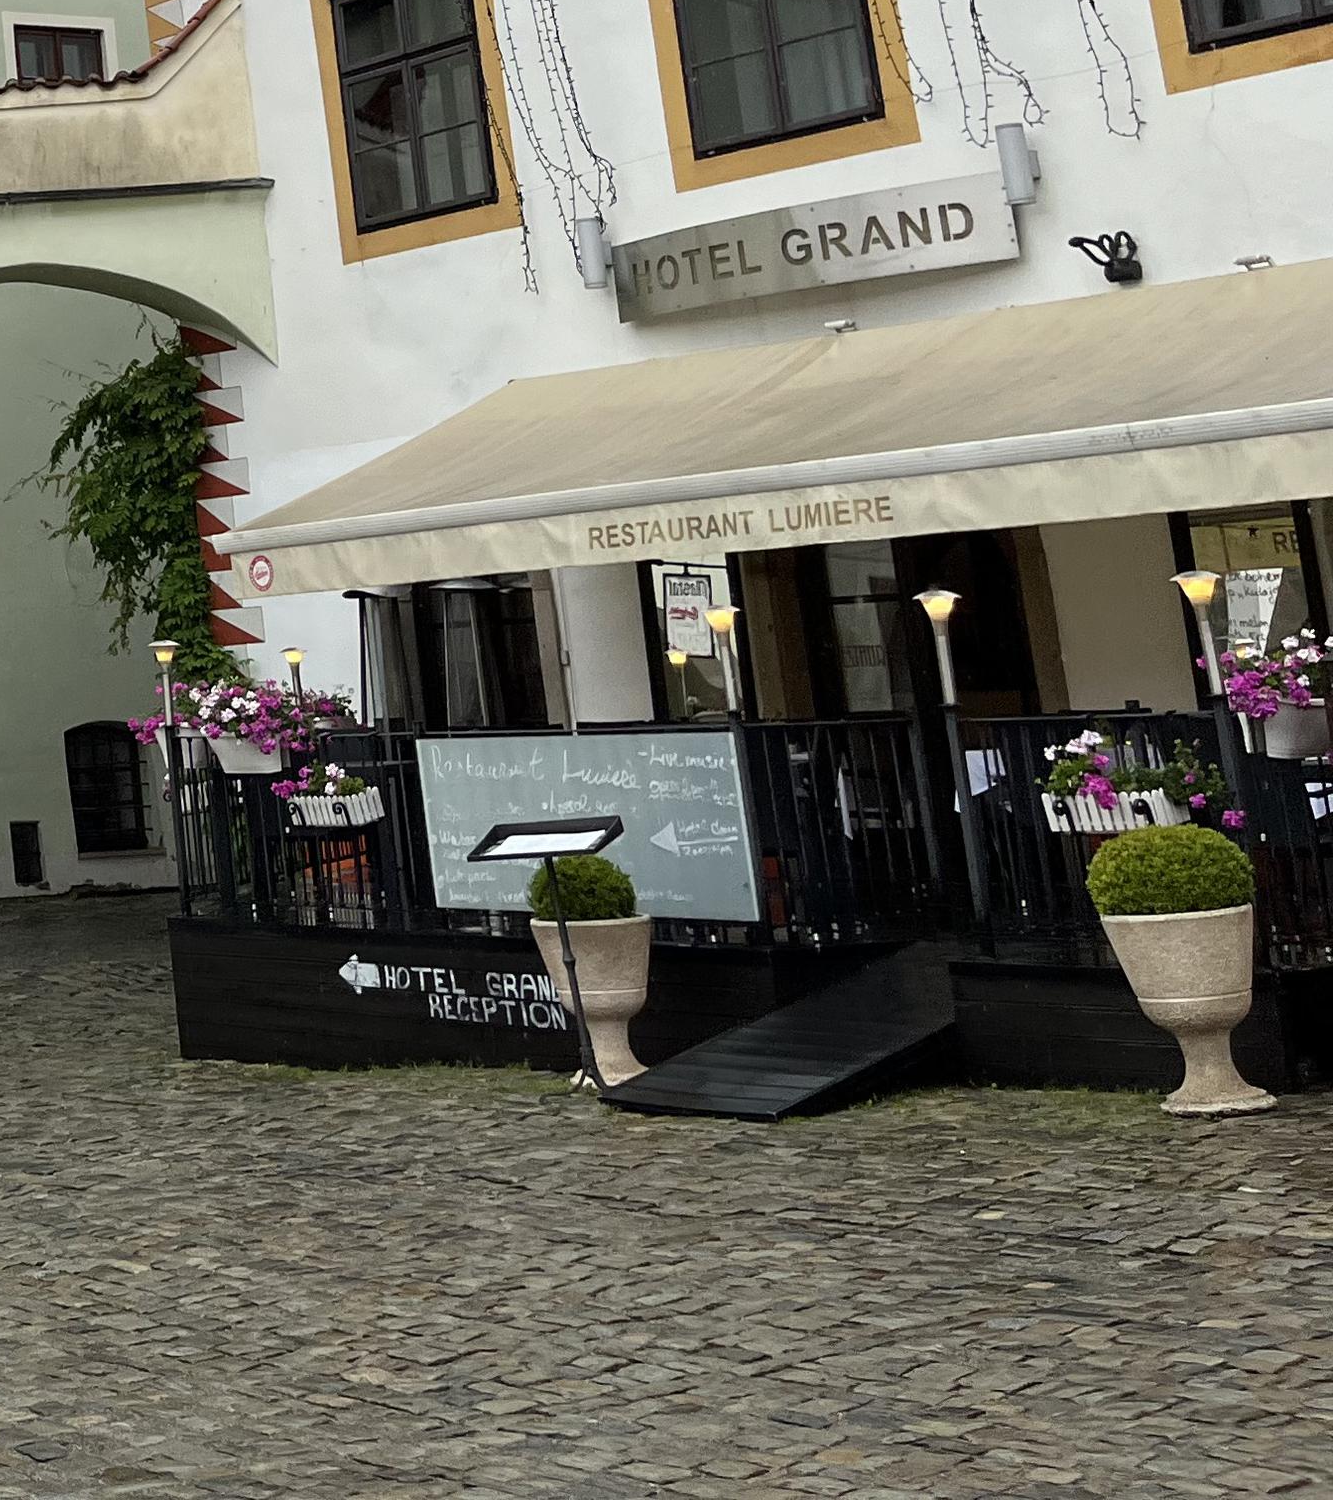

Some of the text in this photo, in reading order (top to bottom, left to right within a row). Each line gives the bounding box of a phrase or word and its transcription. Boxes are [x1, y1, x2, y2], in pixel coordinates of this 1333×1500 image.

[633, 202, 975, 298] HOTEL GRAND
[588, 510, 754, 550] RESTAURANT
[383, 965, 466, 995] HOTEL
[428, 993, 568, 1031] RECEPTION
